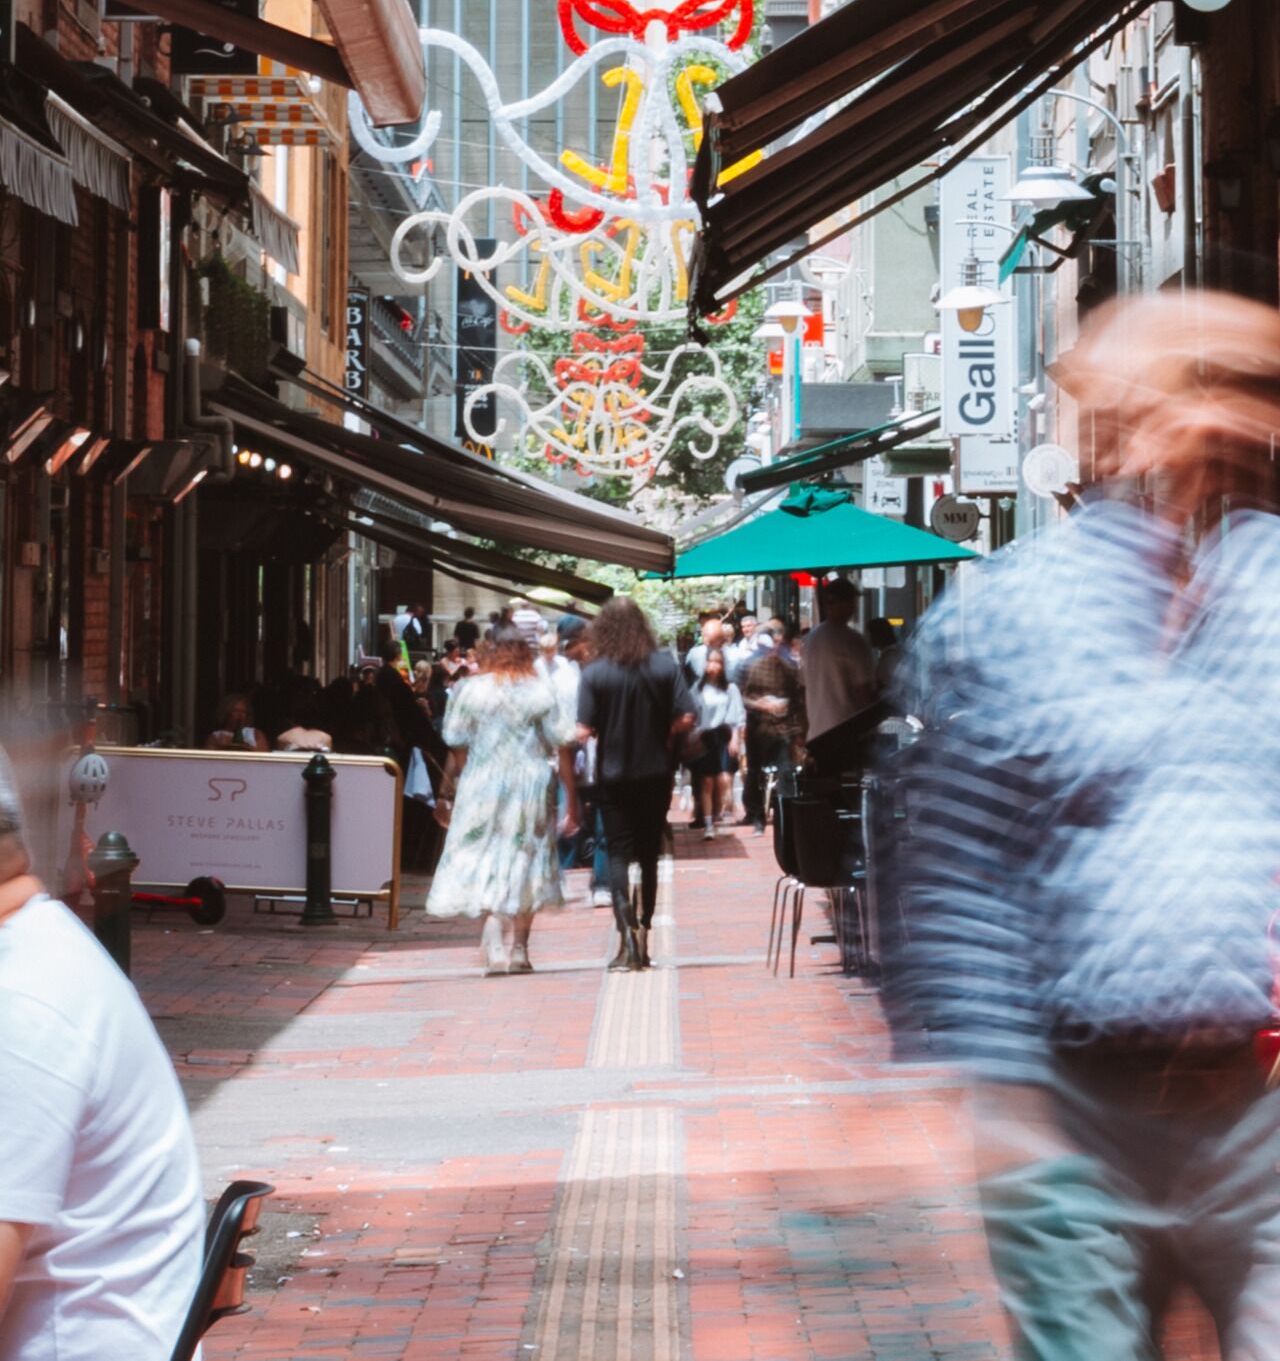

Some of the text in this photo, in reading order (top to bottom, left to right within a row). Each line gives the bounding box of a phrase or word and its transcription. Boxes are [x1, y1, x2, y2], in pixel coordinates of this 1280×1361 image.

[967, 188, 978, 238] REAL
[983, 165, 995, 238] ESTATE
[345, 306, 367, 391] BARB
[943, 512, 969, 524] MM
[167, 814, 286, 832] STEVE PALLAS
